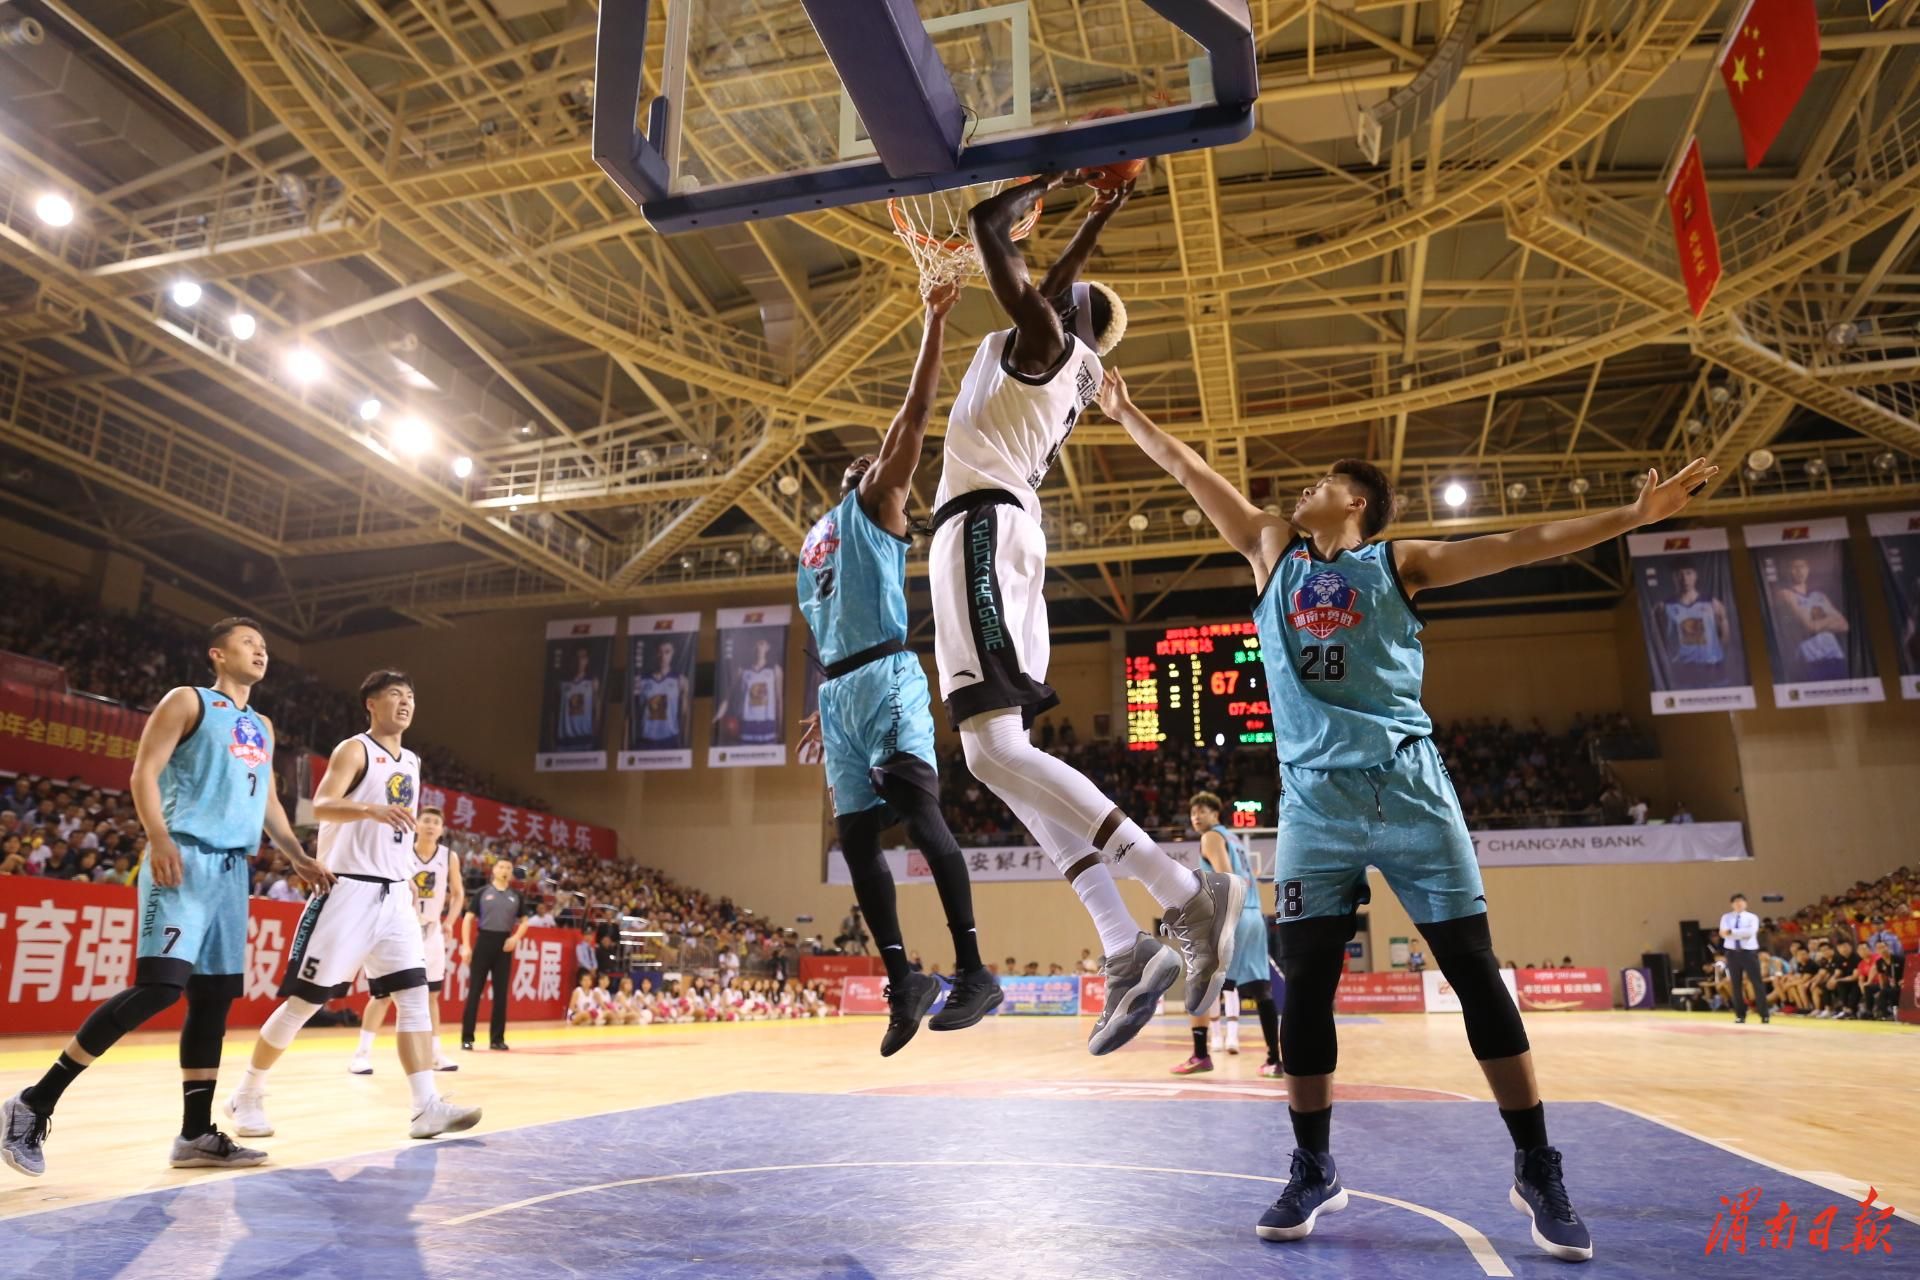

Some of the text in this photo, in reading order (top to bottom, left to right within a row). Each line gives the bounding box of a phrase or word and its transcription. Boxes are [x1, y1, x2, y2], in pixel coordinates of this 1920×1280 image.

[972, 518, 1005, 651] SHOCK THE GAME
[1300, 645, 1345, 681] 28
[1210, 671, 1240, 695] 67
[247, 772, 257, 797] 7
[497, 806, 593, 851] 天天快乐
[1233, 811, 1256, 827] 05
[1487, 835, 1646, 852] CHANG'AN BANK
[0, 899, 136, 1004] 育强
[162, 926, 182, 955] 7
[302, 956, 320, 979] 5
[512, 938, 562, 1001] 发展
